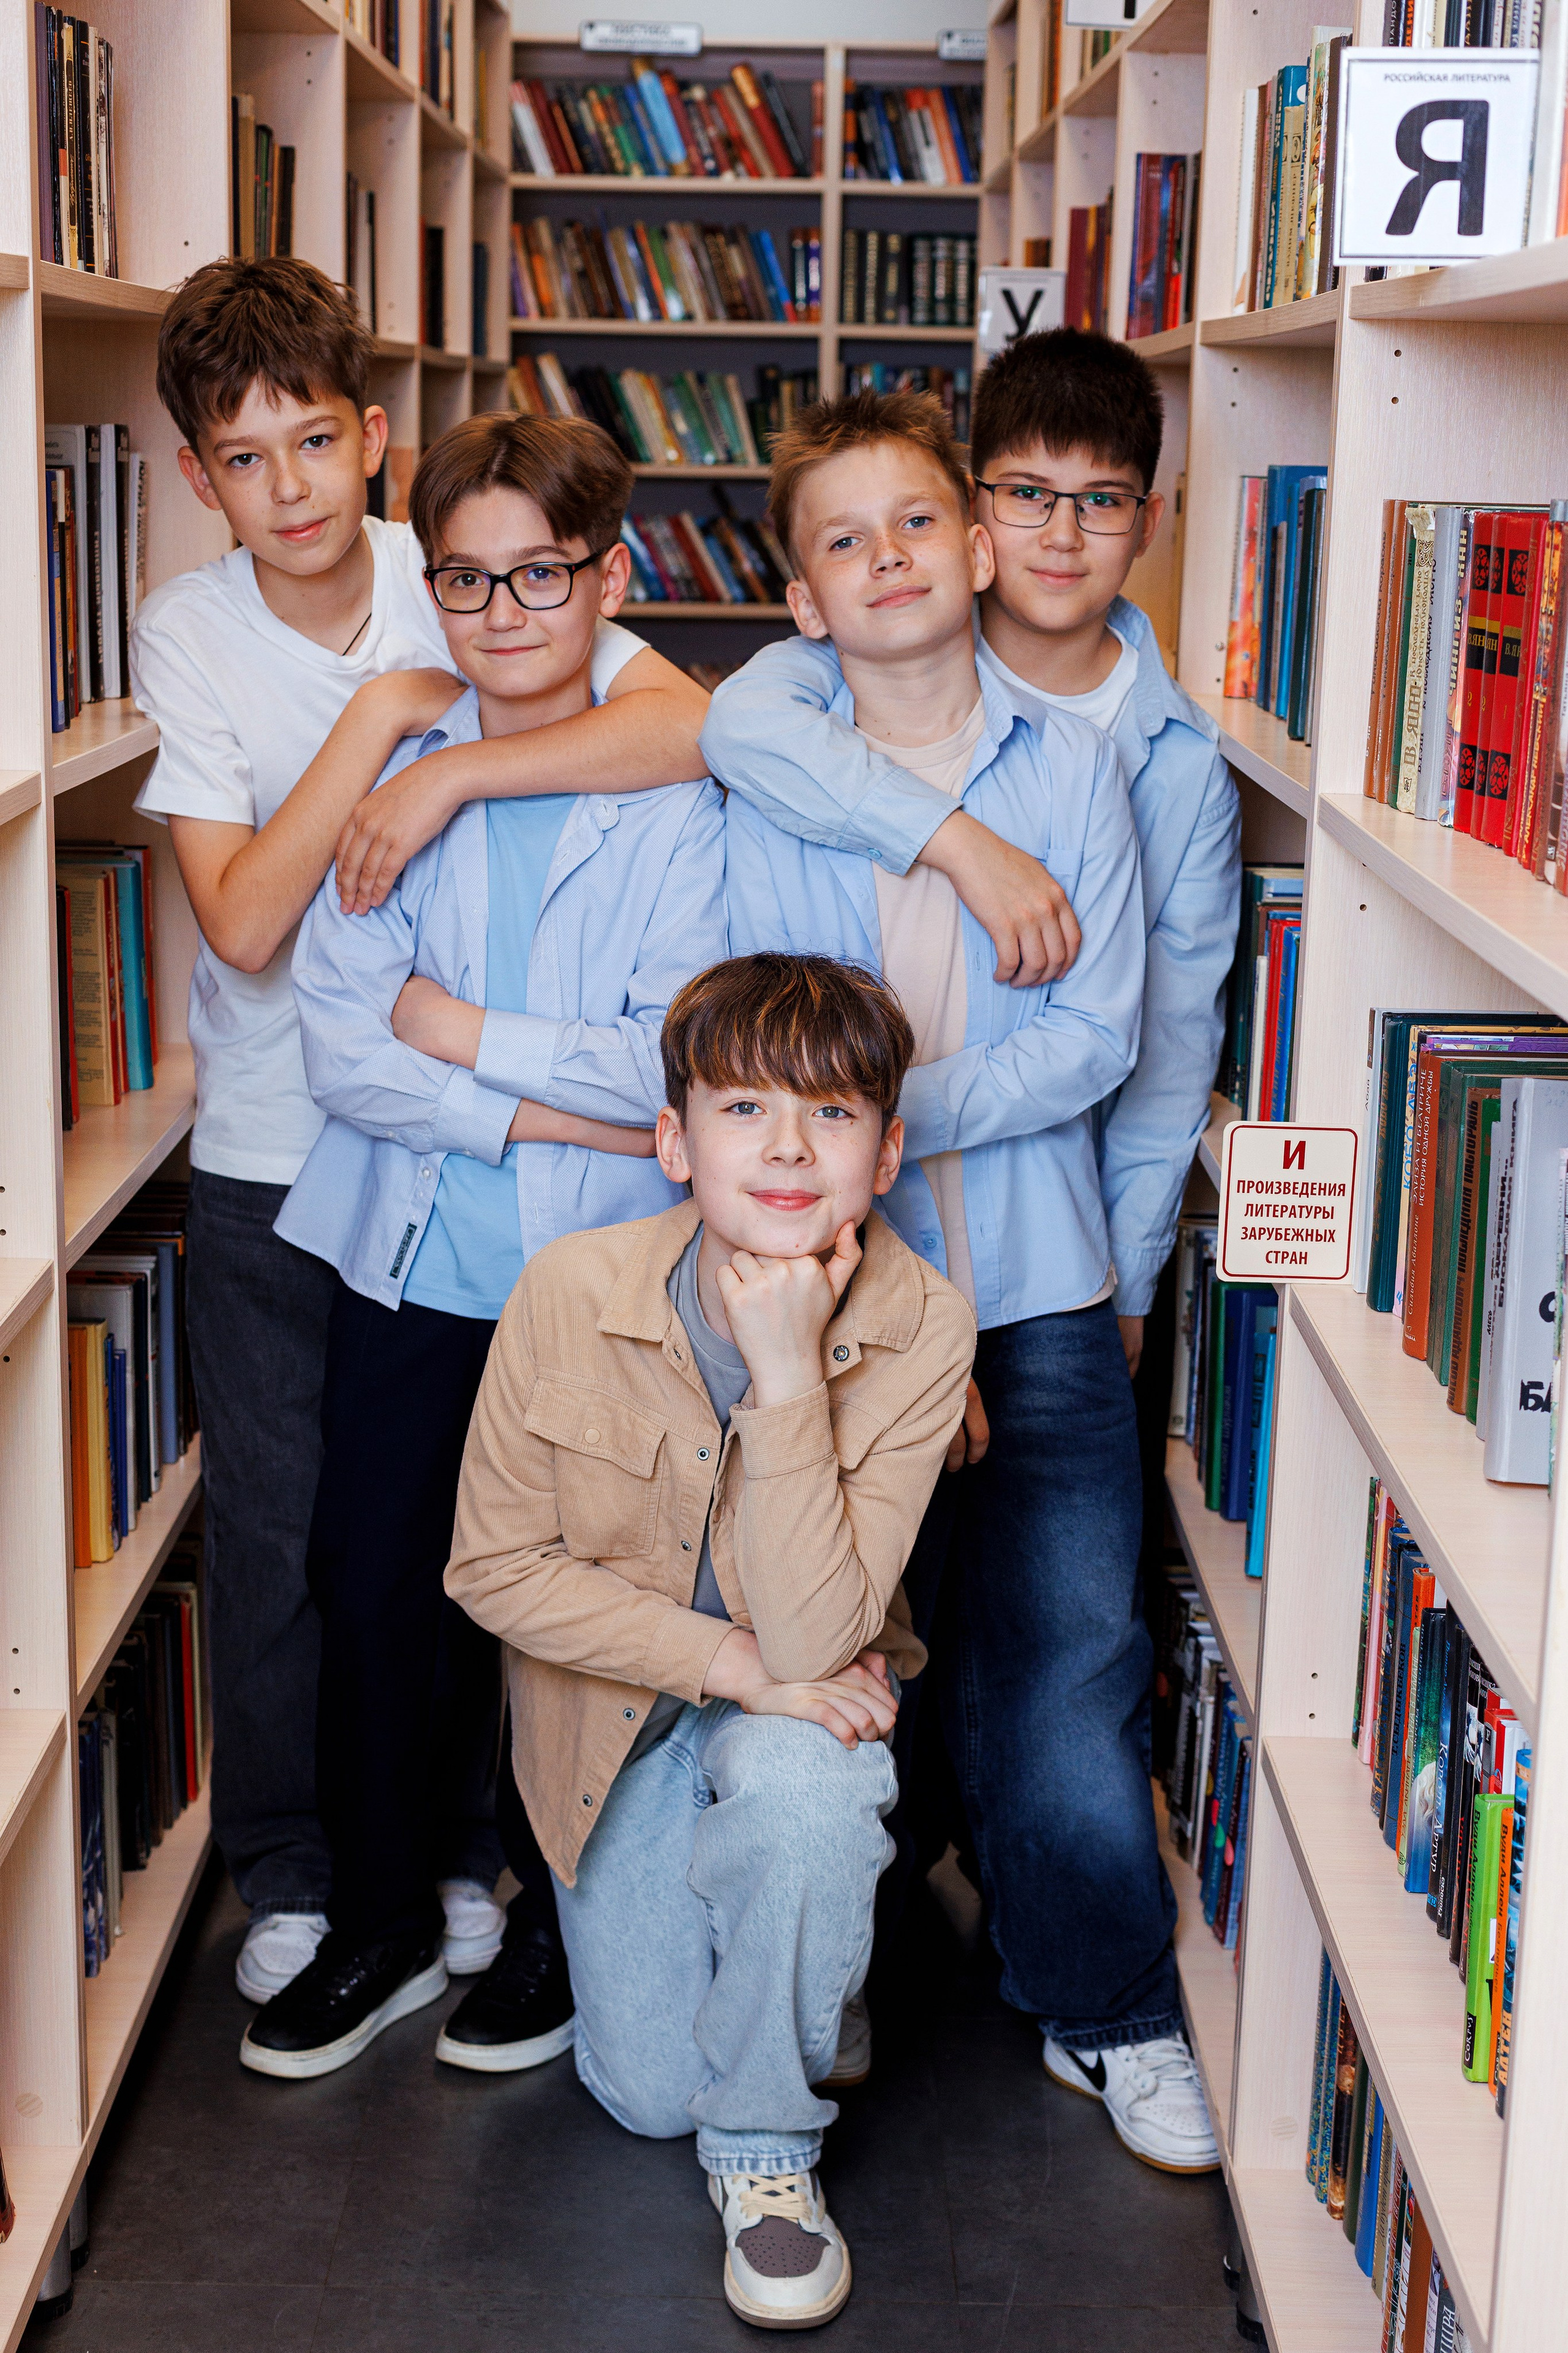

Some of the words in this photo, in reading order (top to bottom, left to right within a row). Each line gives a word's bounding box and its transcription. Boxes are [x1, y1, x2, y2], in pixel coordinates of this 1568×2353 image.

[1384, 72, 1449, 82] РОССИЙСКАЯ
[1450, 74, 1510, 83] ЛИТЕРАТУРА
[1385, 99, 1490, 236] Я
[1002, 289, 1044, 342] У
[1449, 599, 1462, 696] ЧИНГИЗ
[1457, 529, 1467, 578] ХАН
[1468, 692, 1472, 706] 2
[1482, 696, 1486, 711] 2
[1403, 743, 1417, 766] В.
[1523, 771, 1536, 844] АЛЕКСАНДР
[1408, 1063, 1417, 1111] АБЭ
[1417, 1068, 1427, 1136] БЕАТРИЧЕ
[1283, 1140, 1306, 1169] И
[1403, 1125, 1414, 1190] КОБО
[1415, 1143, 1422, 1153] И
[1419, 1158, 1427, 1206] ИСТОРИЯ
[1425, 1070, 1434, 1114] ДРУЖБЫ
[1237, 1180, 1346, 1198] ПРОИЗВЕДЕНИЯ
[1411, 1158, 1420, 1204] ЭЛИЗА
[1240, 1226, 1336, 1242] ЗАРУБЕЖНЫХ
[1244, 1203, 1335, 1219] ЛИТЕРАТУРЫ
[1265, 1250, 1308, 1264] СТРАН
[1411, 1215, 1419, 1263] Аваллоне
[1392, 1642, 1406, 1756] Т.СЫДЫКБЕКОВ
[1408, 1711, 1417, 1741] ЛУНА
[1498, 1867, 1507, 1917] Аллен
